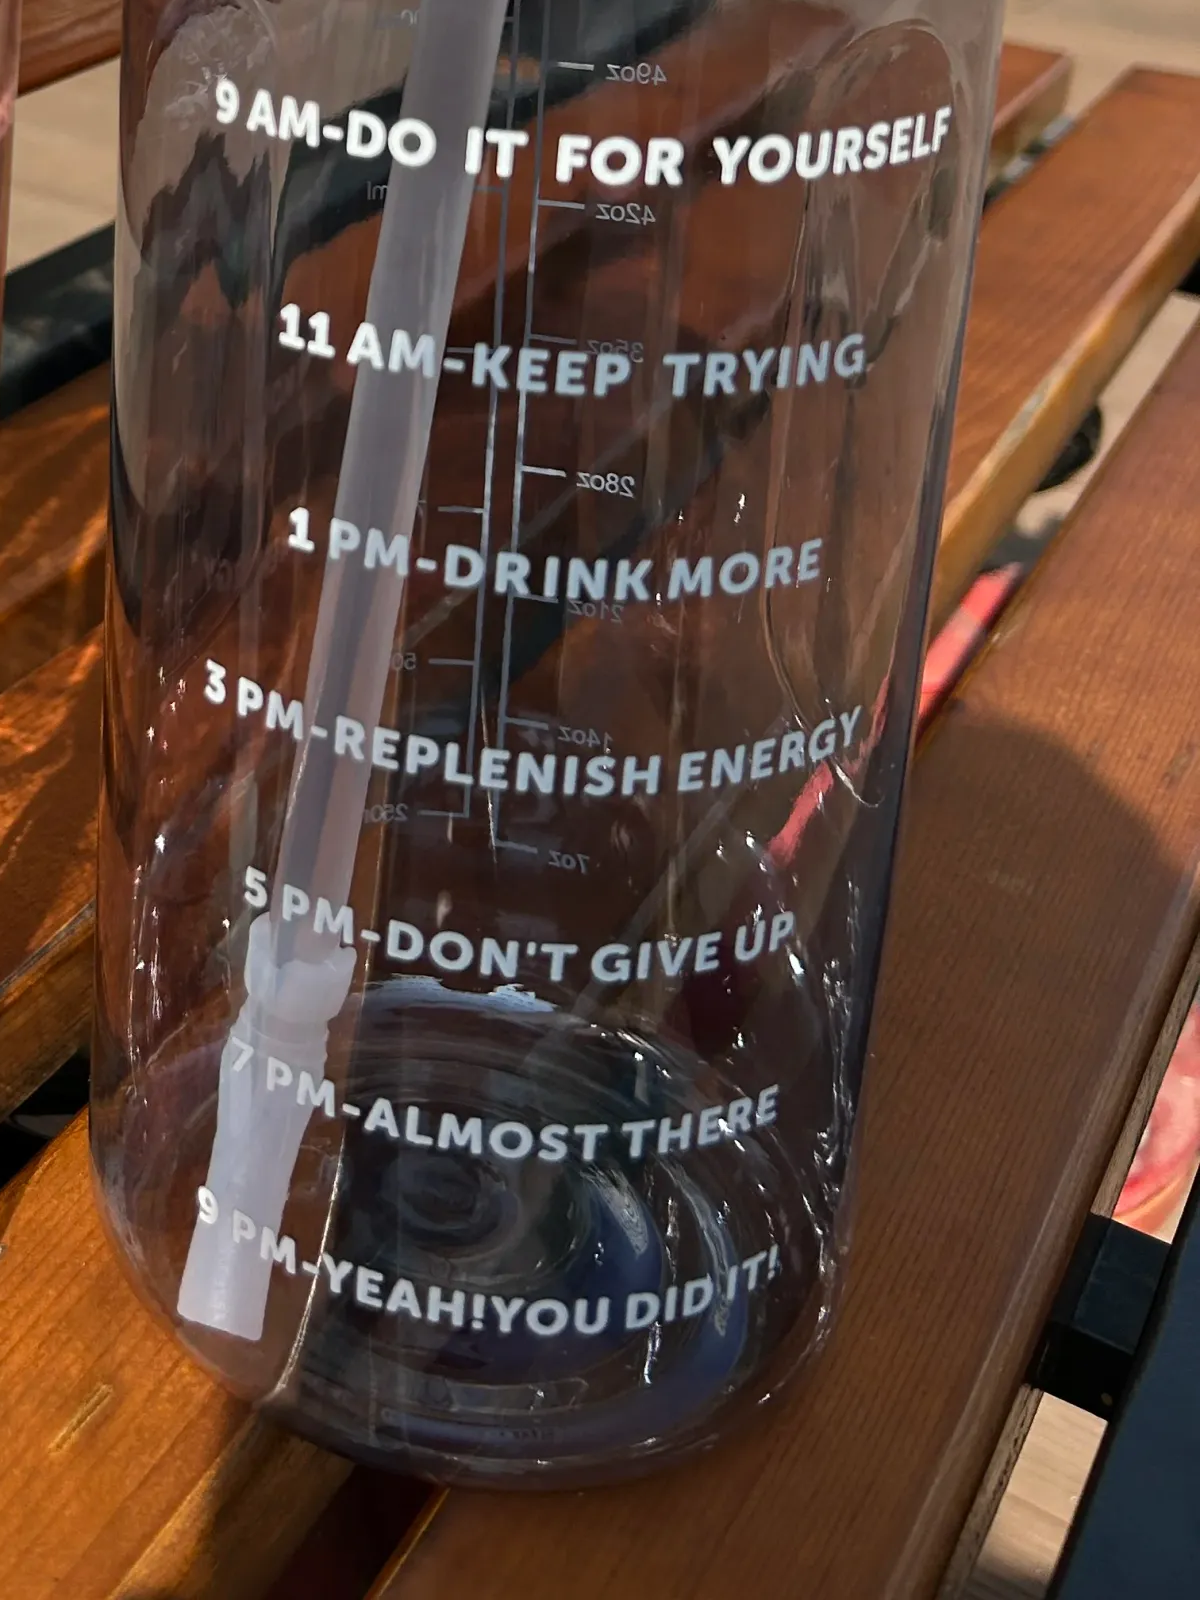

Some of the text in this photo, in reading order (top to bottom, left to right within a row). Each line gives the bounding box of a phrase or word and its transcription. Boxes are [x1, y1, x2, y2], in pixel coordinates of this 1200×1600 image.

[214, 77, 952, 187] 9 AM-DO IT FOR YOURSELF
[278, 303, 868, 398] 11 AM-KEEP TRYING
[287, 506, 823, 602] 1 PM-DRINK MORE
[203, 658, 864, 796] 3 PM-REPLENISH ENERGY
[242, 865, 797, 984] 5 PM-DON'T GIVE UP
[230, 1036, 781, 1162] 7 PM-ALMOST THERE
[196, 1184, 218, 1225] 9
[624, 1279, 713, 1333] DID
[722, 1244, 782, 1304] IT!
